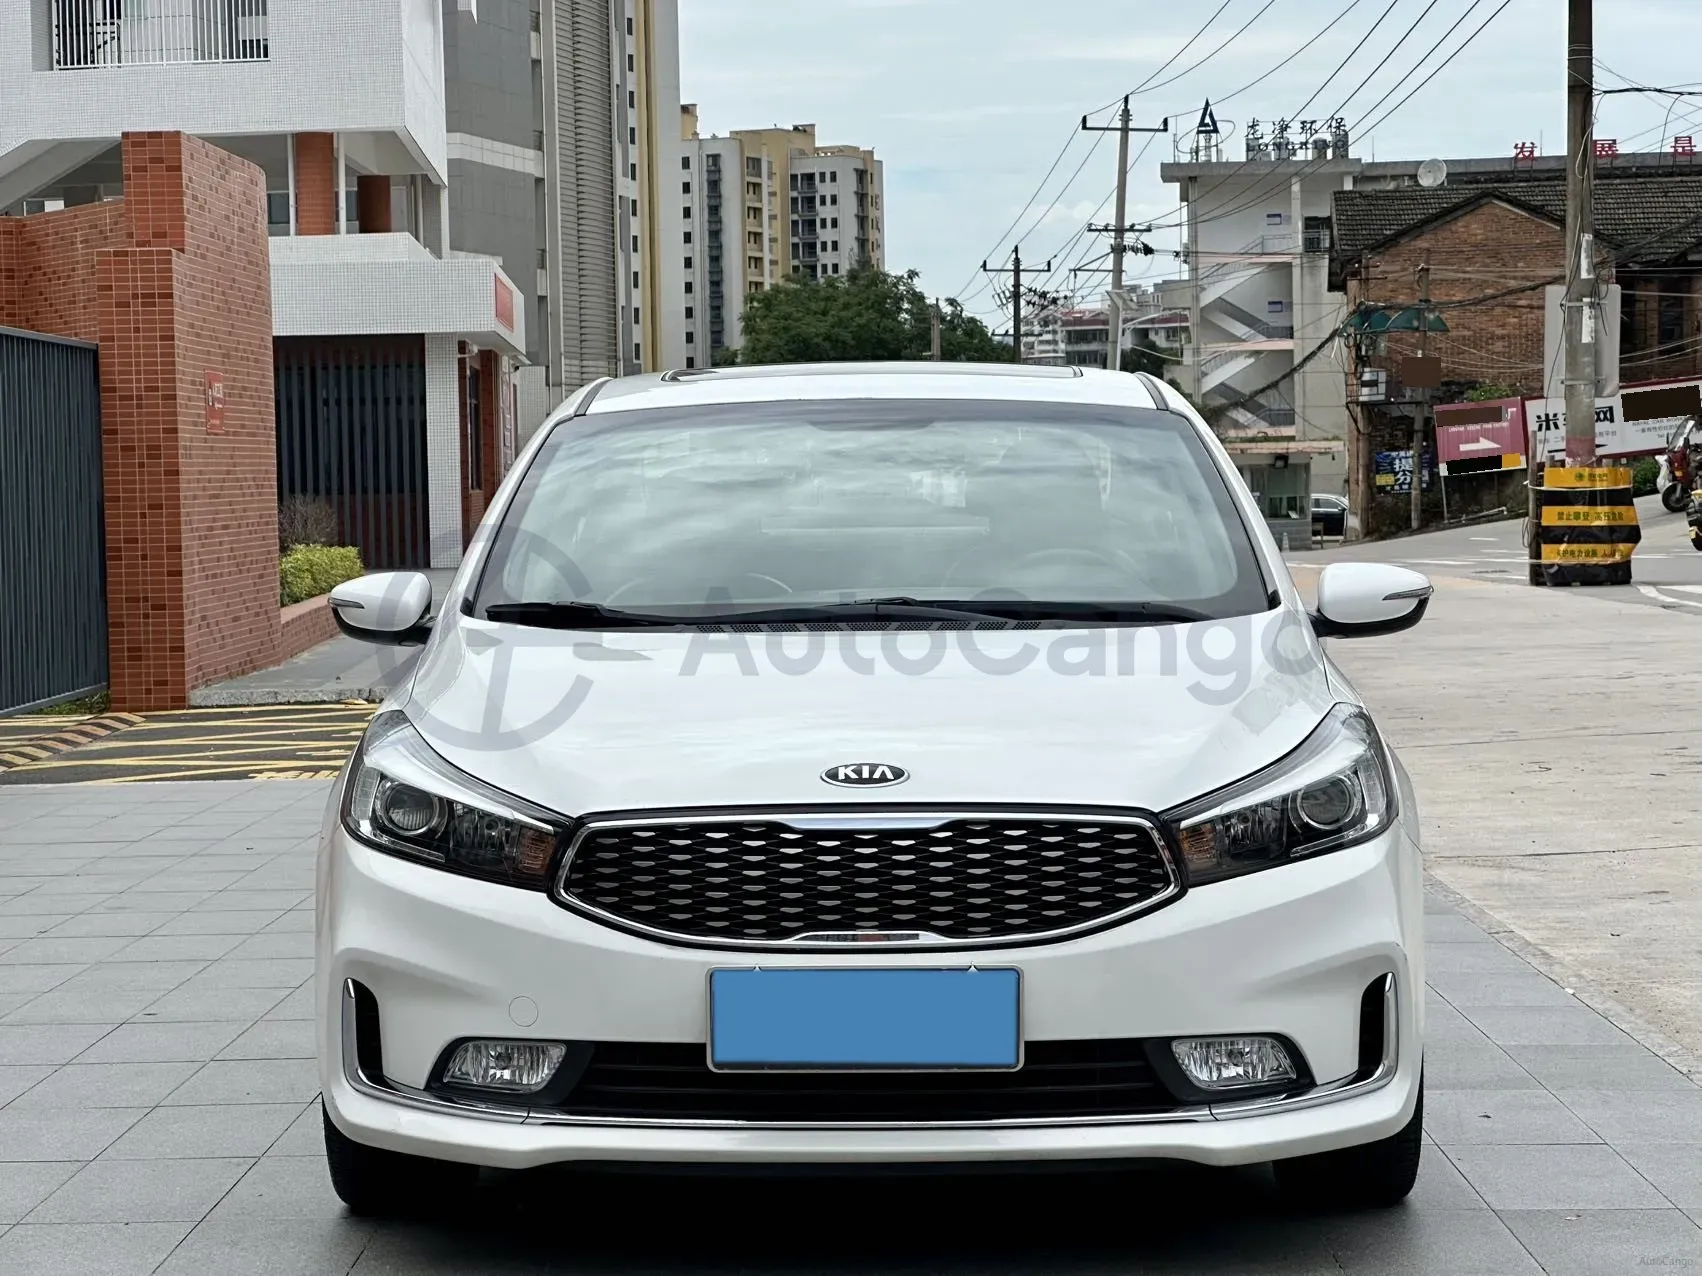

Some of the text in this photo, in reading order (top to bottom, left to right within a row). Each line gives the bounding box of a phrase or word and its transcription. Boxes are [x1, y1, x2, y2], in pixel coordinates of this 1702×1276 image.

[1244, 117, 1347, 139] 龙净环保
[1536, 406, 1615, 432] 米网
[838, 765, 895, 780] KIA
